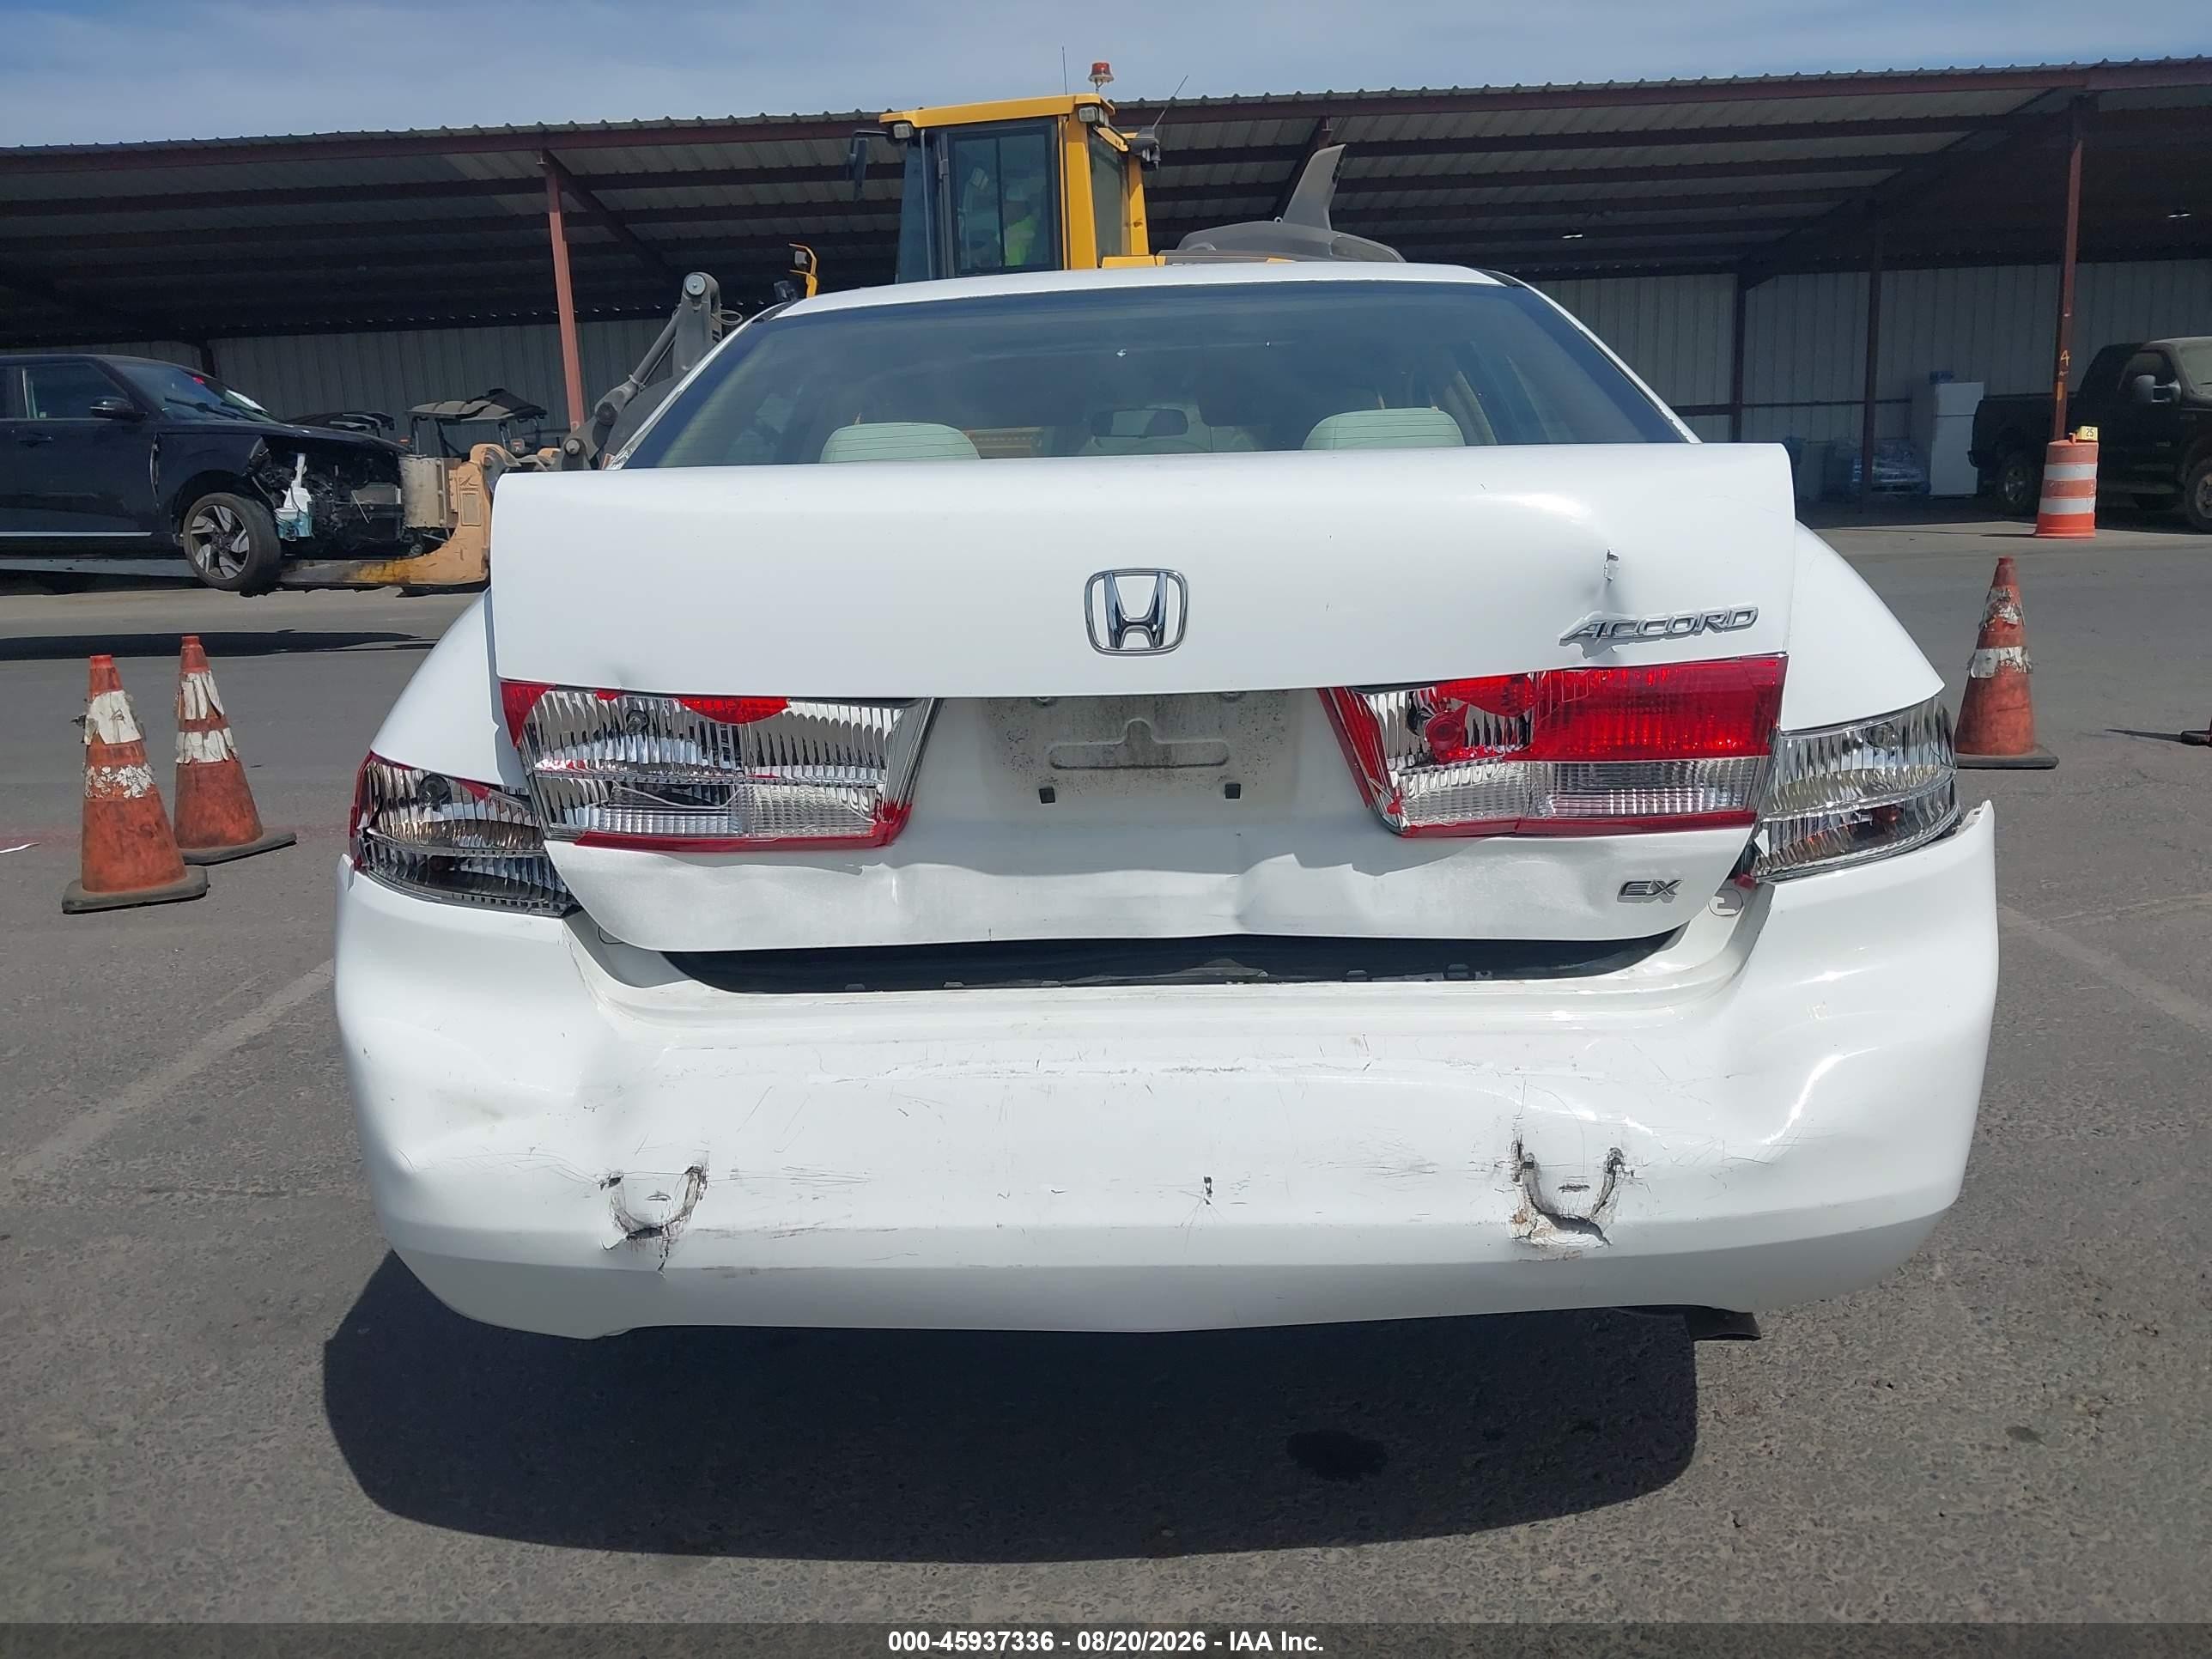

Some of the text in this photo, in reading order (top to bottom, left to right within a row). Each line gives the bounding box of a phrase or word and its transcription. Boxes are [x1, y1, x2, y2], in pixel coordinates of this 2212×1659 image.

[2060, 349, 2070, 367] 4
[2086, 428, 2094, 437] 25
[1559, 605, 1759, 643] ACCORD
[1620, 878, 1683, 897] EX
